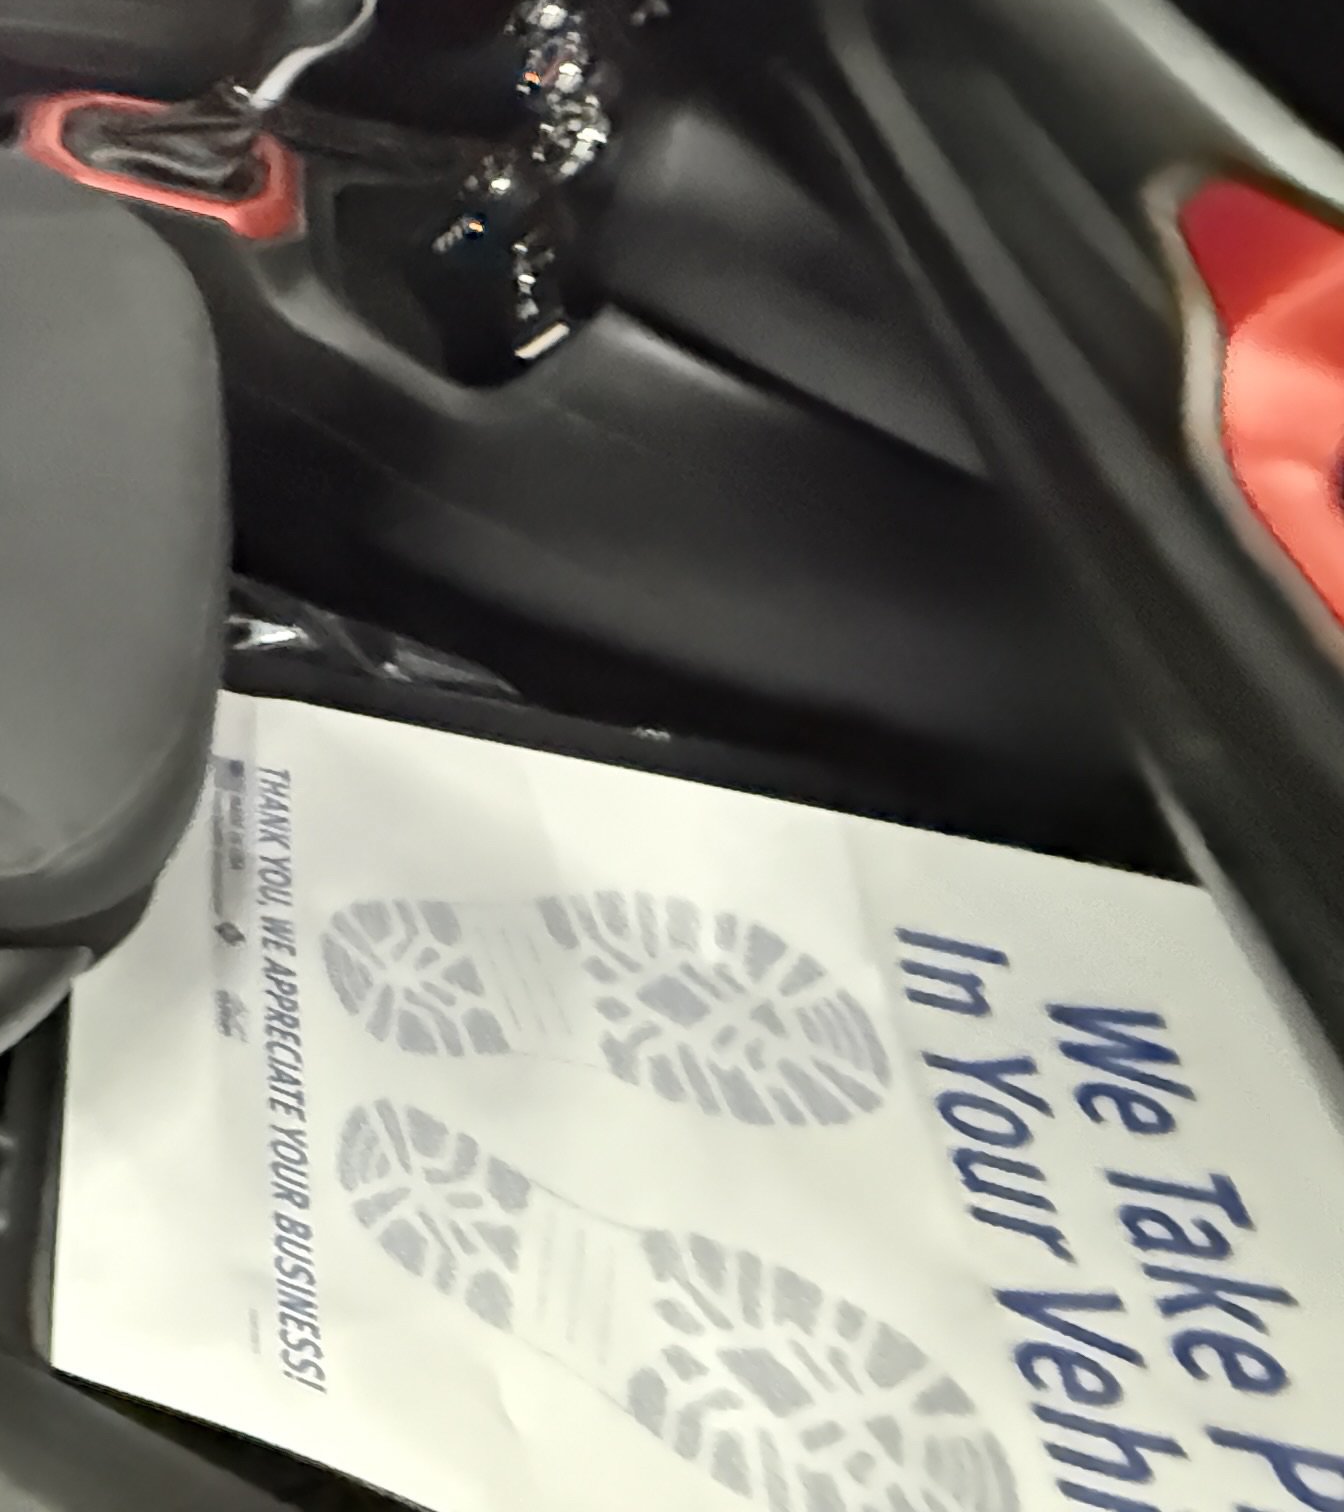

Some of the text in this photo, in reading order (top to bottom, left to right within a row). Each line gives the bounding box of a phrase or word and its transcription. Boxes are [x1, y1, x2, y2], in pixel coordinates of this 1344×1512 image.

[257, 765, 327, 1394] THANK YOU, WE APPRECIATE YOUR BUSINESS!
[894, 927, 1010, 1019] In
[922, 1050, 1077, 1265] Your
[1045, 1003, 1344, 1512] We Take P
